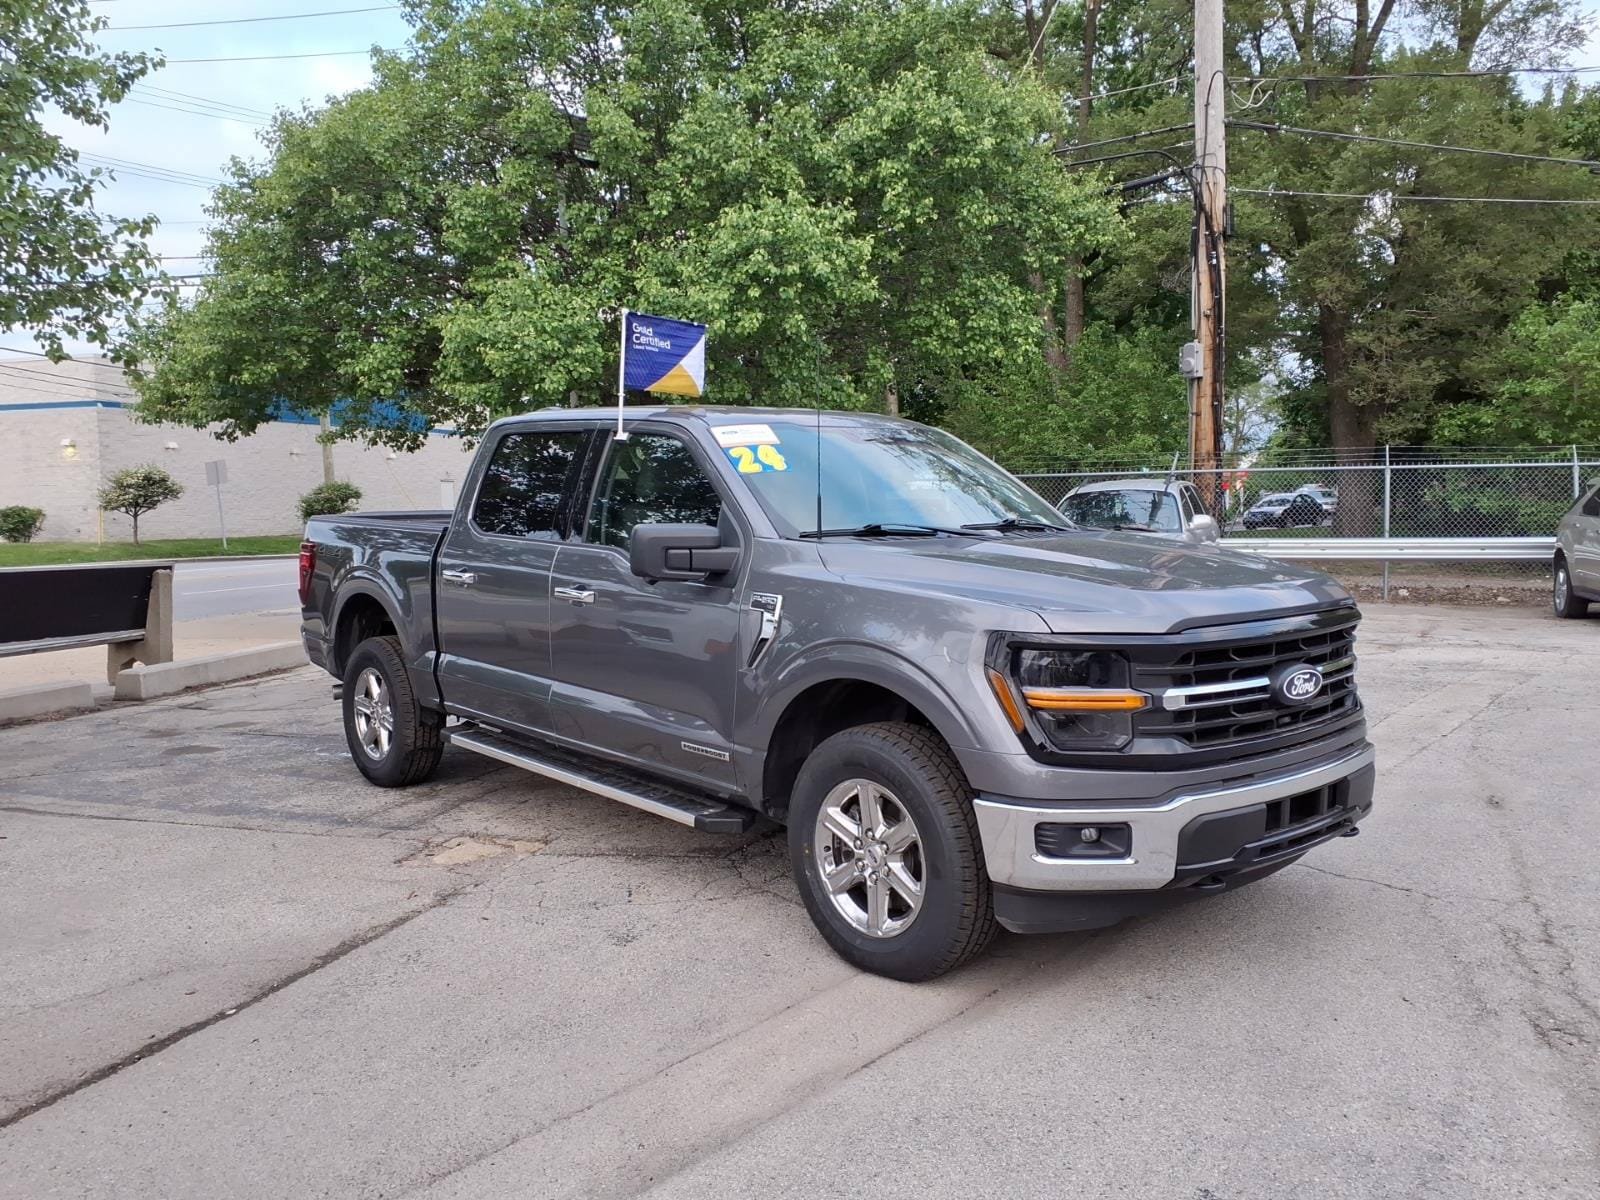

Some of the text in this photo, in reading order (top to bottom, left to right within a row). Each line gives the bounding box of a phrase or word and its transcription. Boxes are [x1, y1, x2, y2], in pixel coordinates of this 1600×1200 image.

[632, 333, 671, 349] Certified
[729, 445, 787, 474] 24
[1291, 673, 1316, 695] Ford
